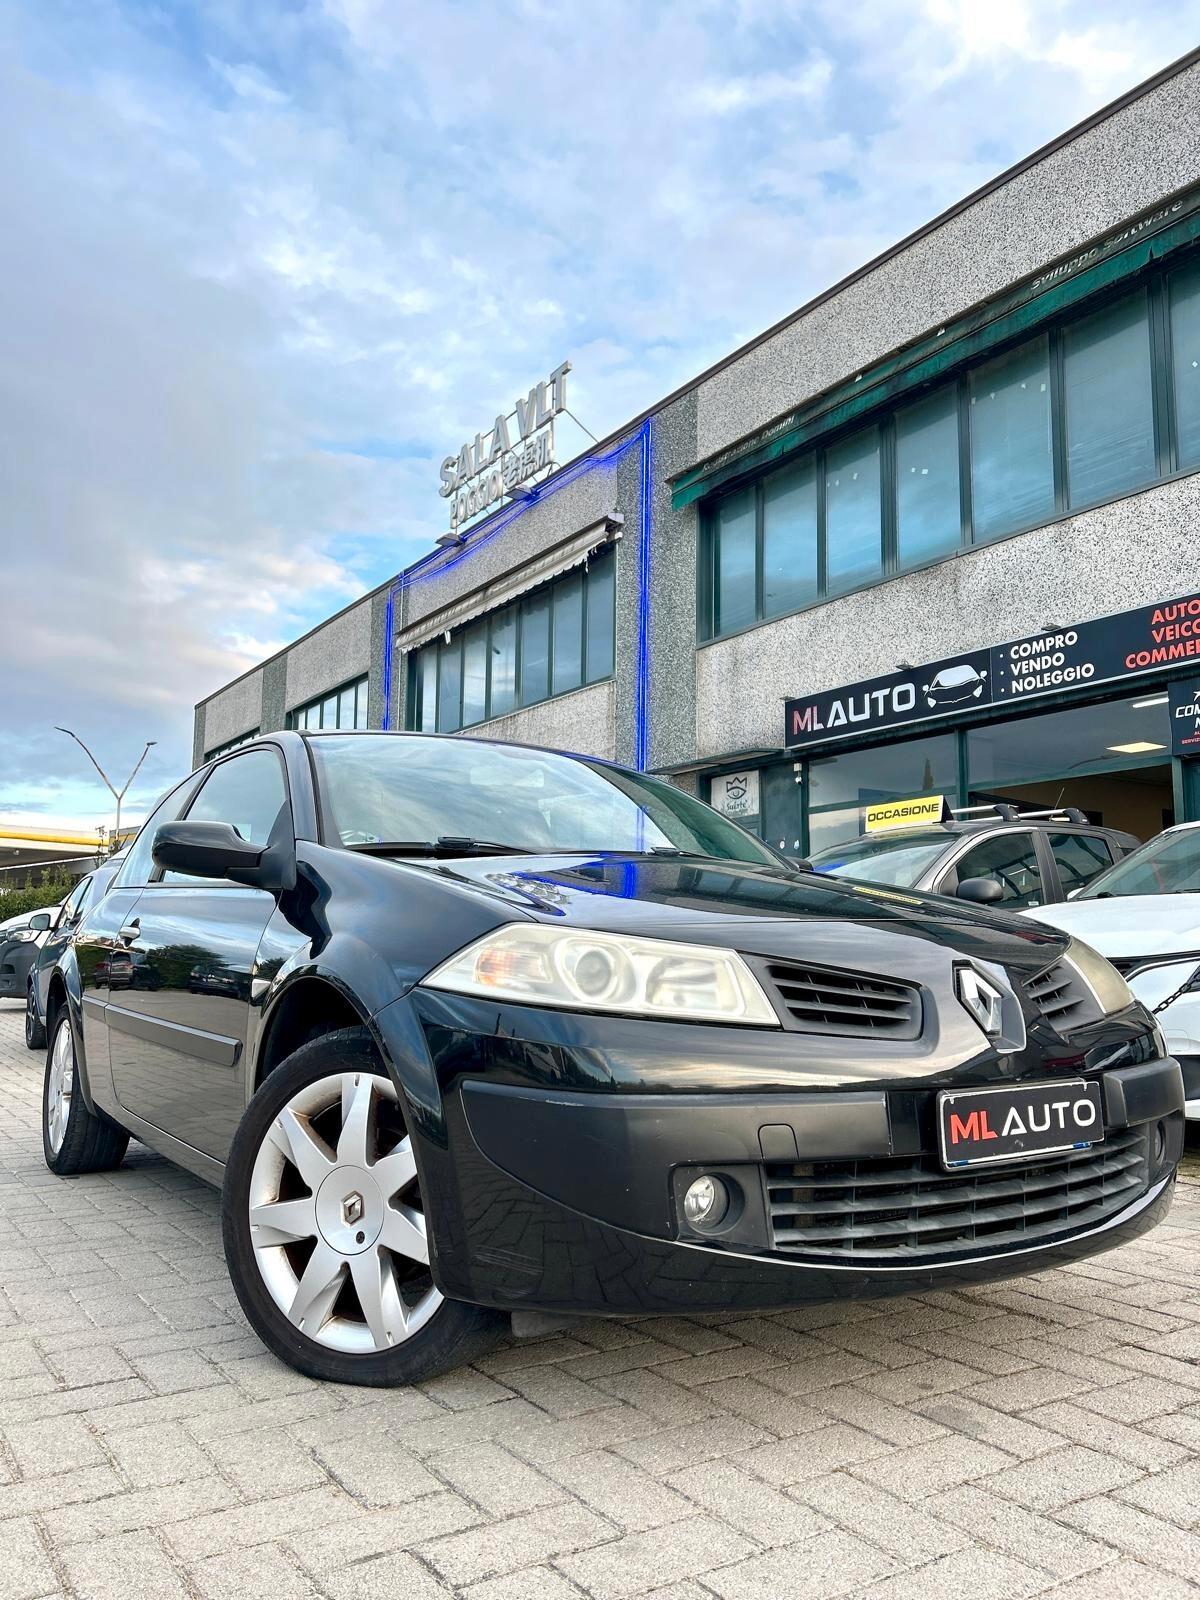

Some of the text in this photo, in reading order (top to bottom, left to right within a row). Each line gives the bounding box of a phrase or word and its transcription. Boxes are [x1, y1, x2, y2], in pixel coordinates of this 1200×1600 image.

[438, 360, 572, 498] SALA VLT
[1151, 599, 1200, 625] AUTO
[1010, 631, 1078, 660] COMPRO
[1010, 653, 1065, 677] VENDO
[1011, 663, 1095, 694] NOLEGGIO
[792, 682, 916, 735] ML AUTO
[867, 803, 939, 822] OCCASIONE
[950, 1099, 1096, 1144] ML AUTO
